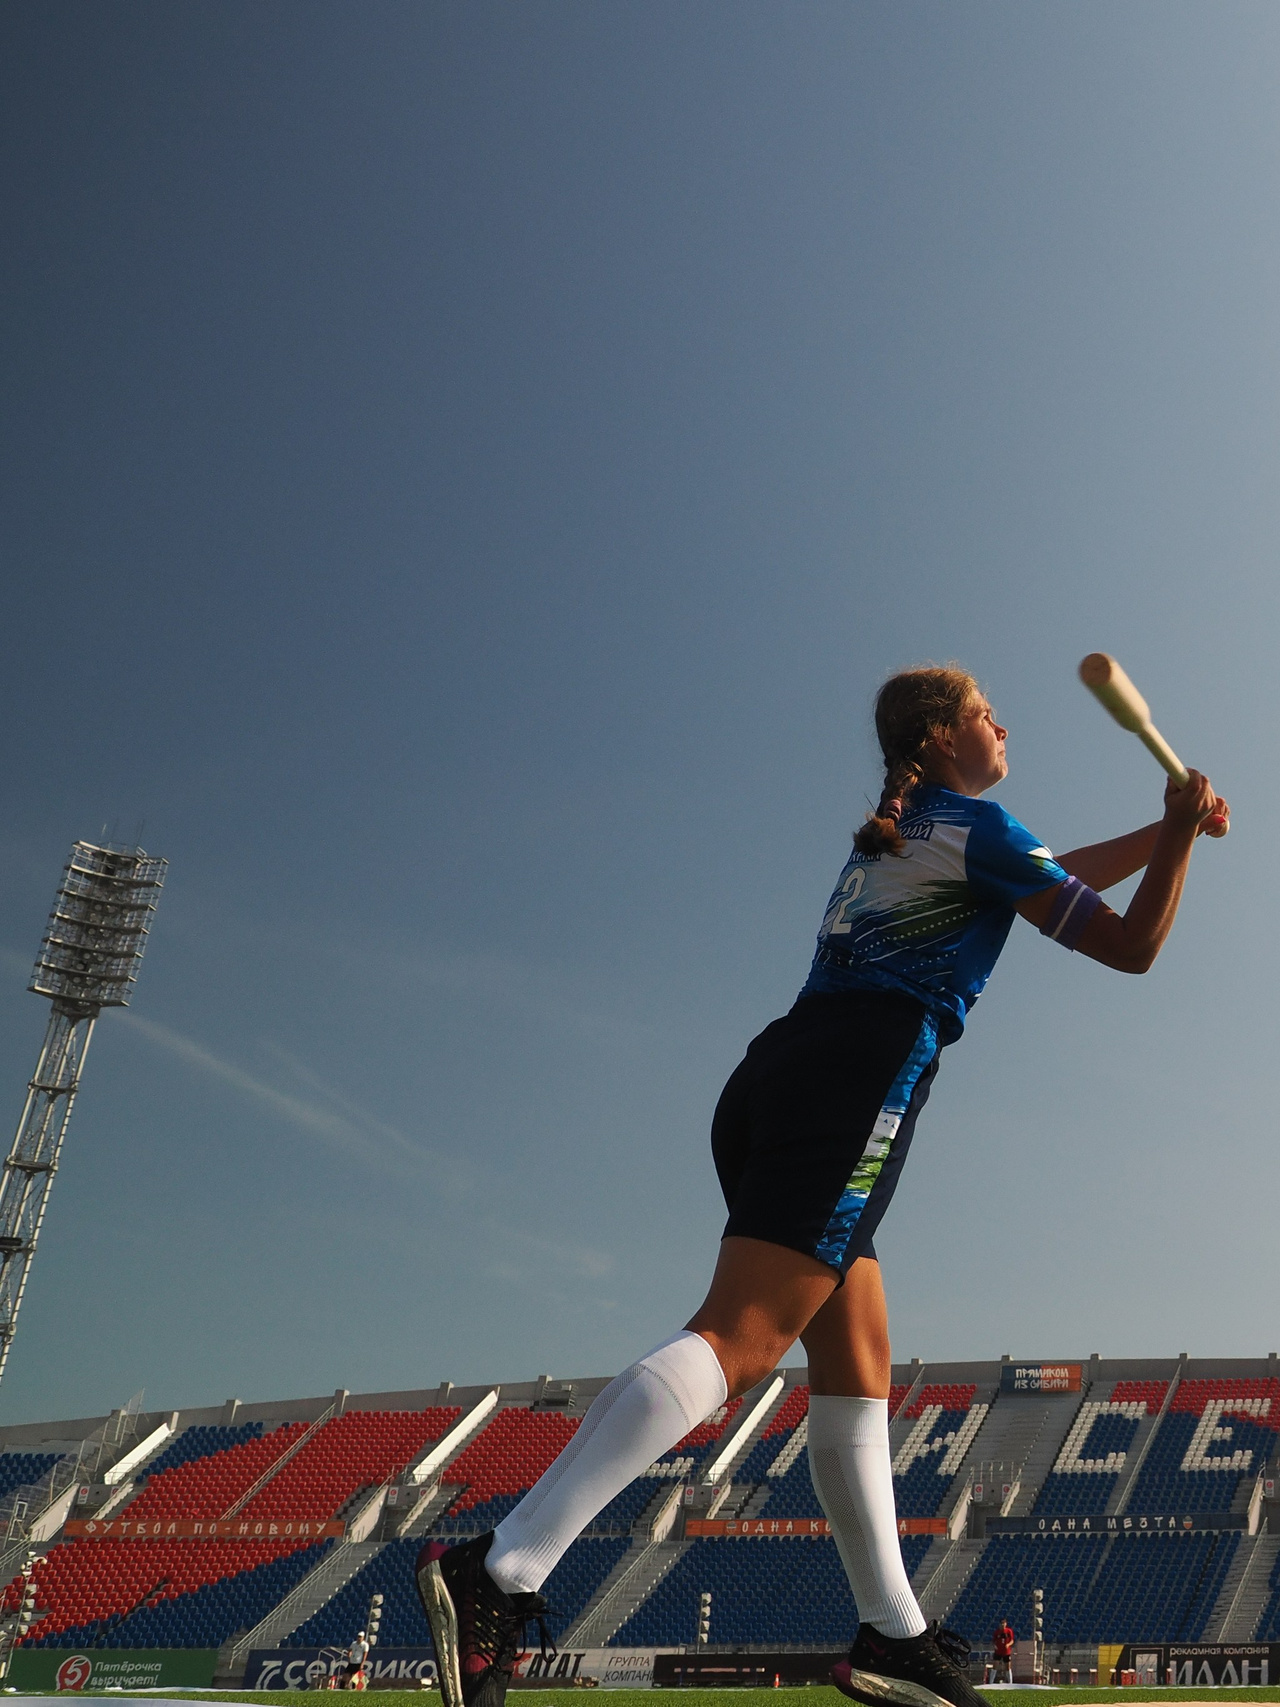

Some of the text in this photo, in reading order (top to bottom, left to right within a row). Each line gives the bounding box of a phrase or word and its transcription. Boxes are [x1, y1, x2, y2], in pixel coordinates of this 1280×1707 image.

[1014, 1379, 1069, 1389] ИЗ СИБИРИ
[85, 1521, 327, 1535] ФУТБОЛ ПО-НОВОМУ
[742, 1520, 794, 1534] ОДНА
[1038, 1518, 1091, 1531] ОДНА
[1169, 1646, 1270, 1657] рекламная компания
[94, 1661, 162, 1673] Пятёрочка
[608, 1656, 650, 1667] ГРУППА
[90, 1674, 158, 1686] выручает!
